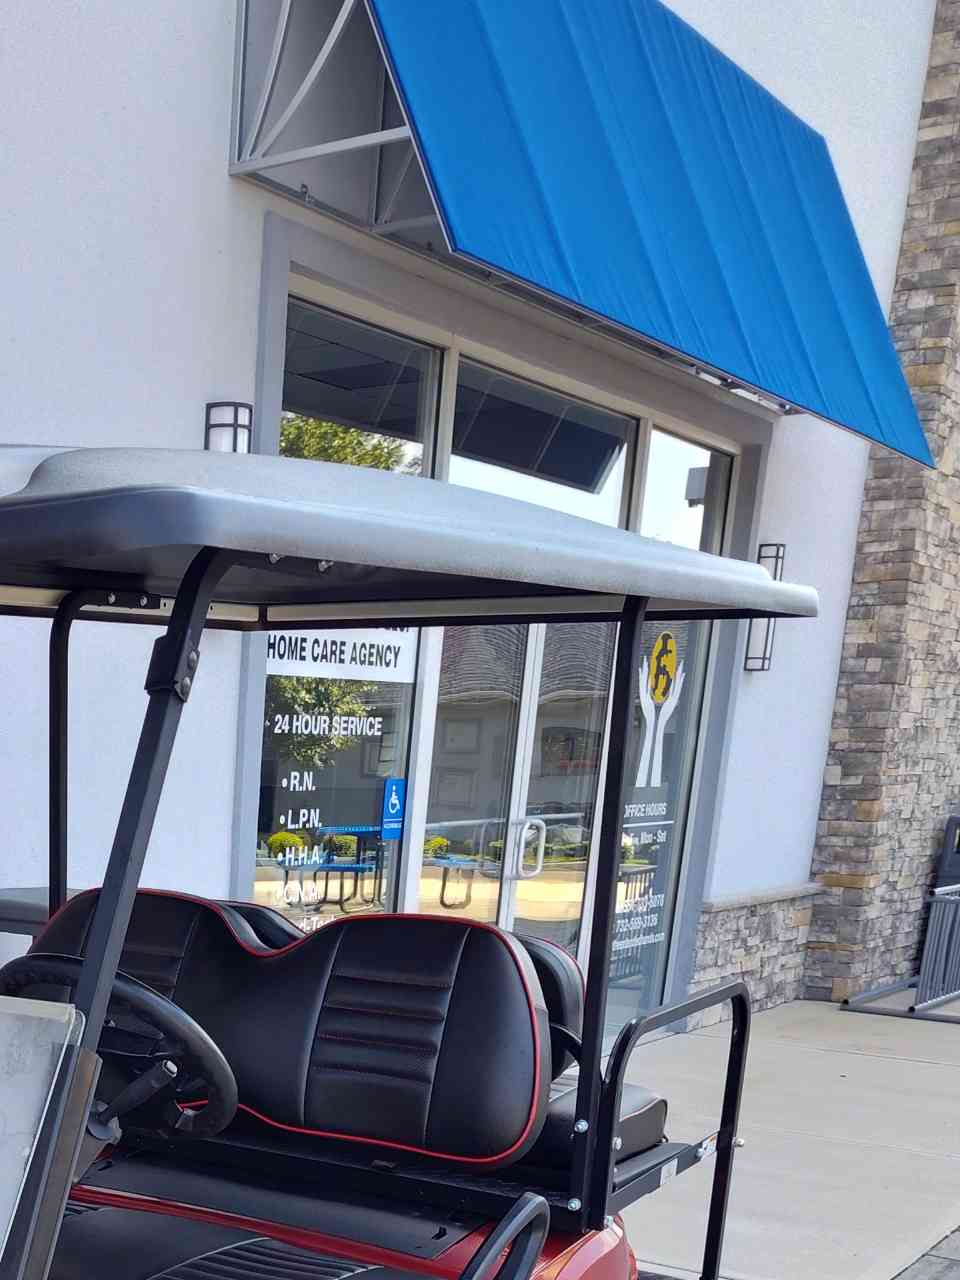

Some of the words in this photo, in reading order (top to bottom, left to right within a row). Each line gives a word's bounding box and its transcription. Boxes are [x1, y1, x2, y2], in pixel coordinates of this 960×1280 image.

[267, 634, 307, 662] HOME
[311, 638, 346, 664] CARE
[350, 642, 401, 668] AGENCY
[274, 714, 289, 734] 24
[292, 714, 330, 735] HOUR
[331, 715, 383, 736] SERVICE
